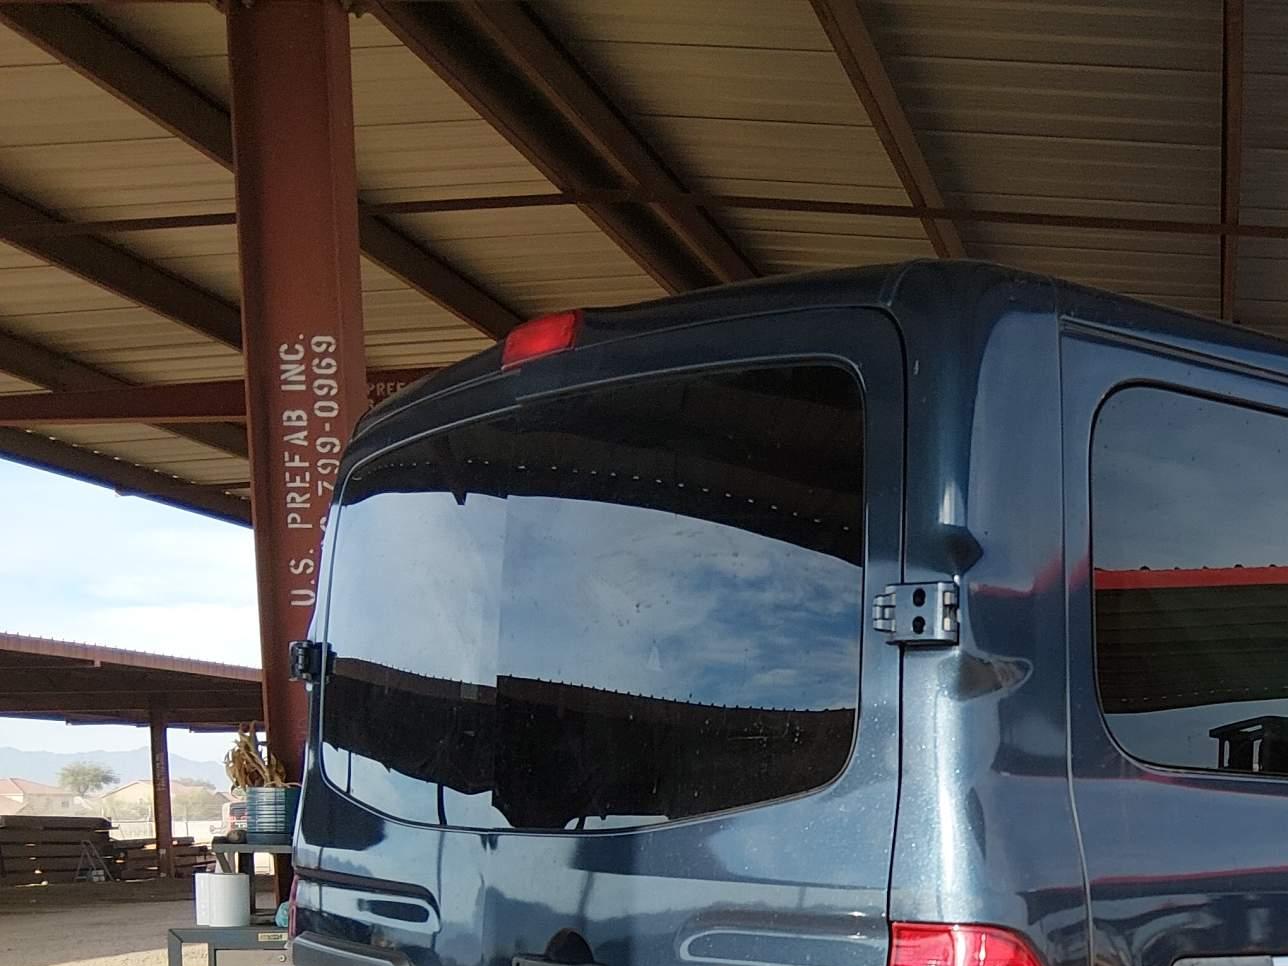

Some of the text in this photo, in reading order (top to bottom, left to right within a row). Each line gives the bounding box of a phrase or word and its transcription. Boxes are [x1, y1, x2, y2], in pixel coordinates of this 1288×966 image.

[279, 333, 316, 606] U.S. PREFAB INC.
